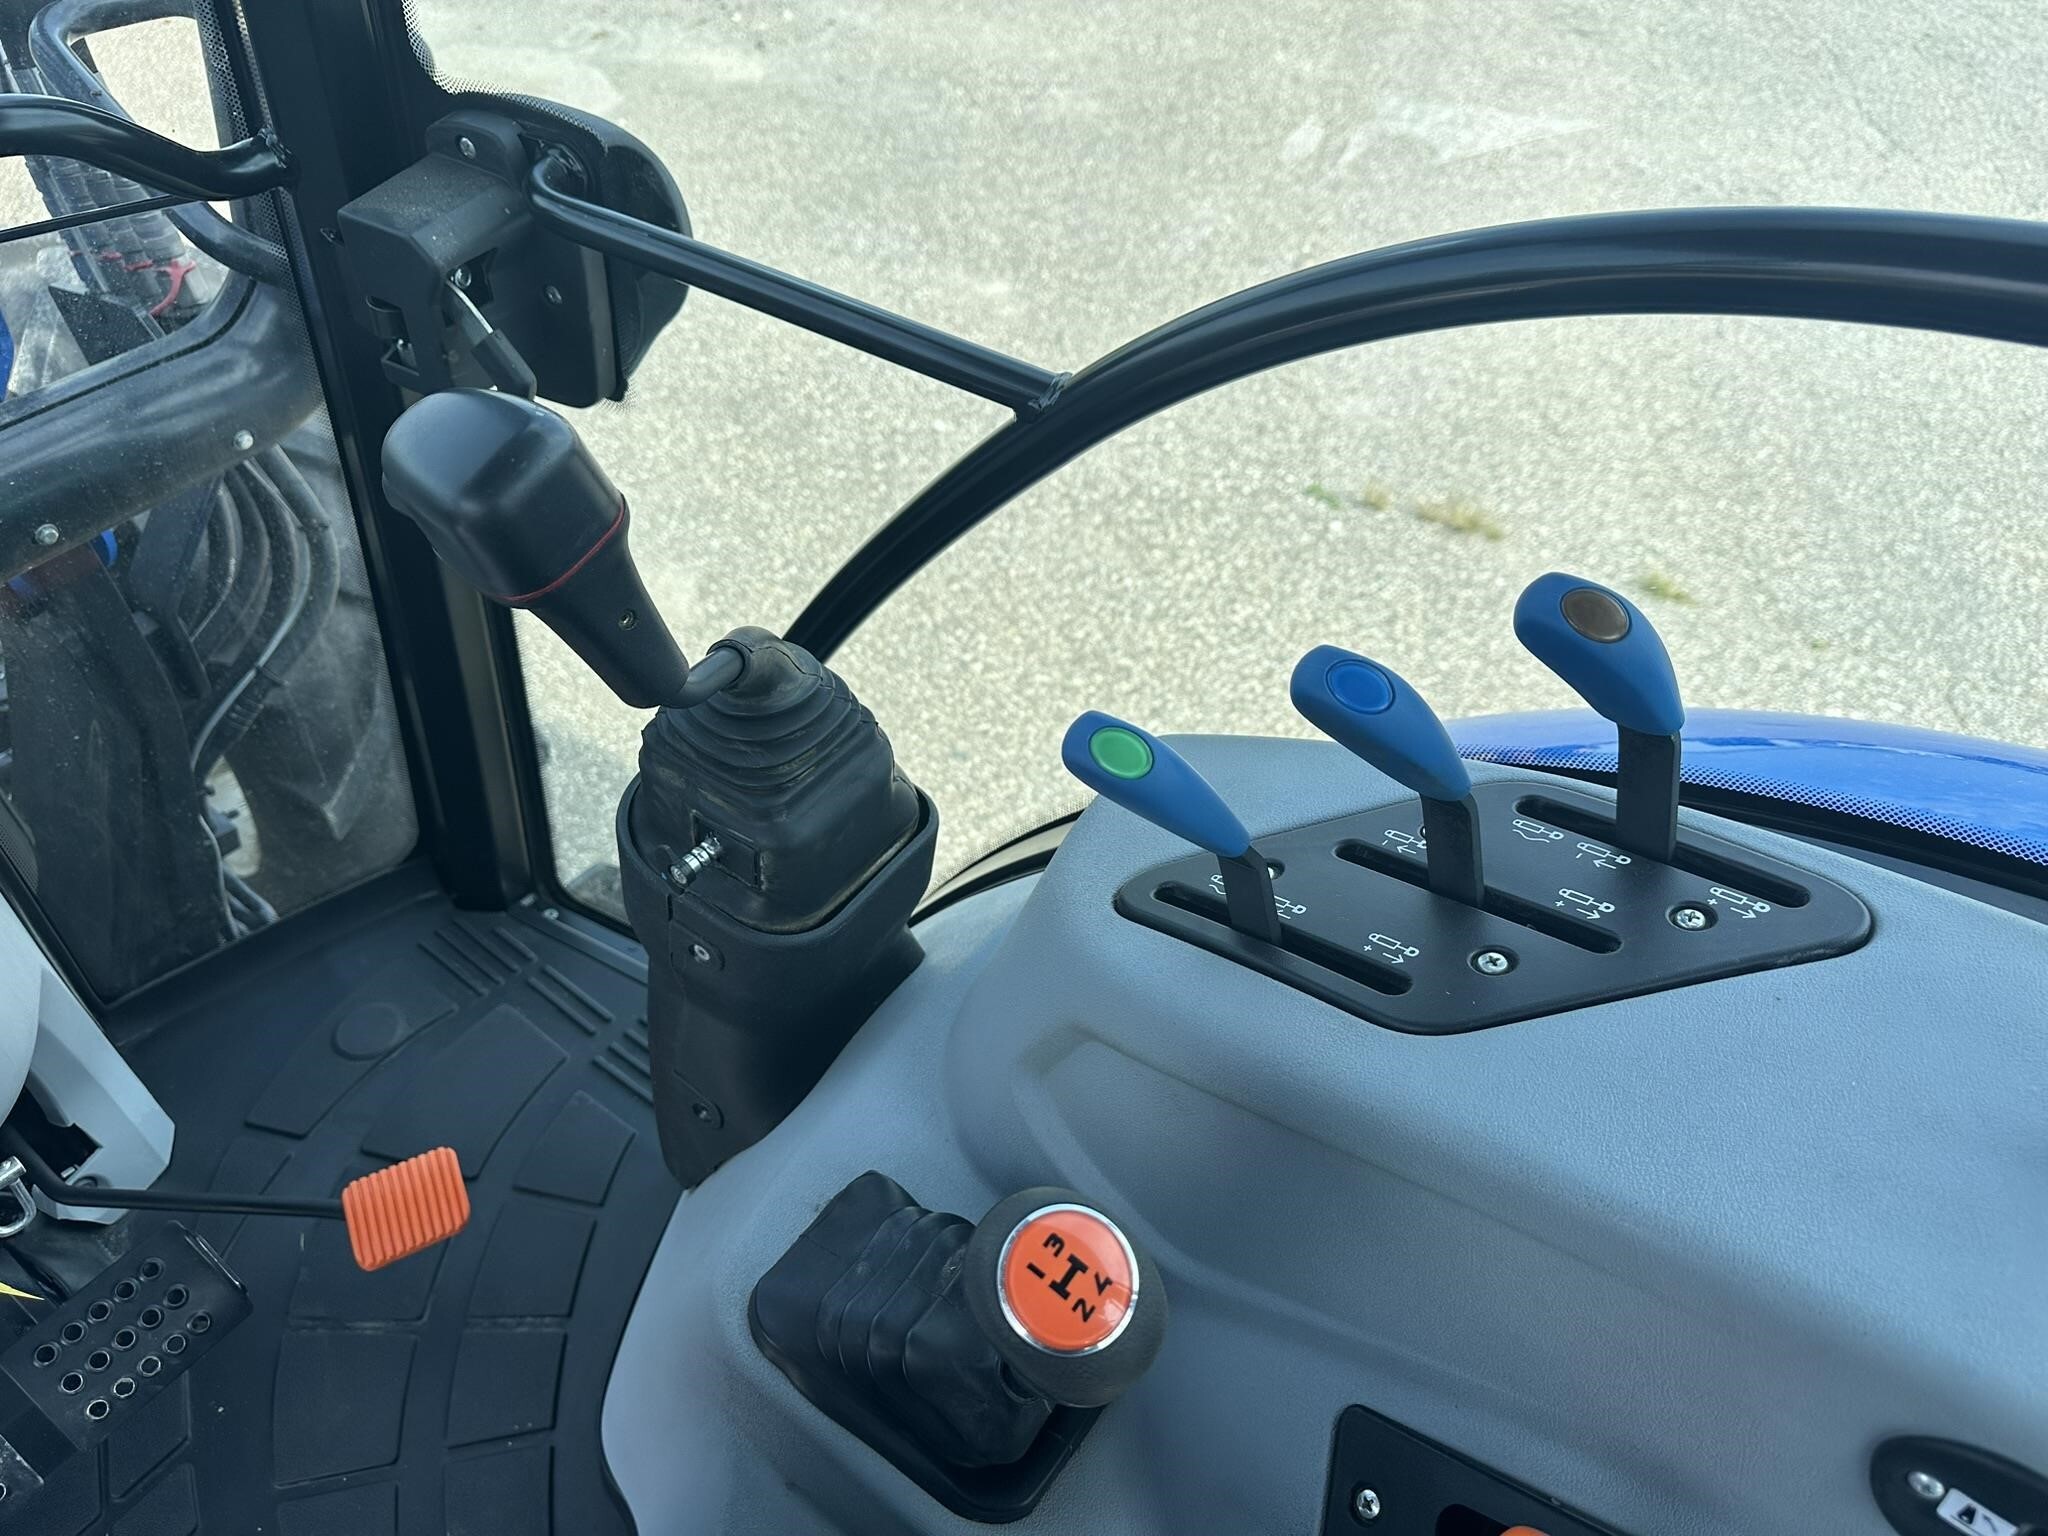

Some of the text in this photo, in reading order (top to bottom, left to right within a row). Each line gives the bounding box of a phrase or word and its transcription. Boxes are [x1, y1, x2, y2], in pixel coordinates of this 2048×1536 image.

[1026, 1233, 1065, 1280] 1 3
[1071, 1271, 1113, 1322] 2 4
